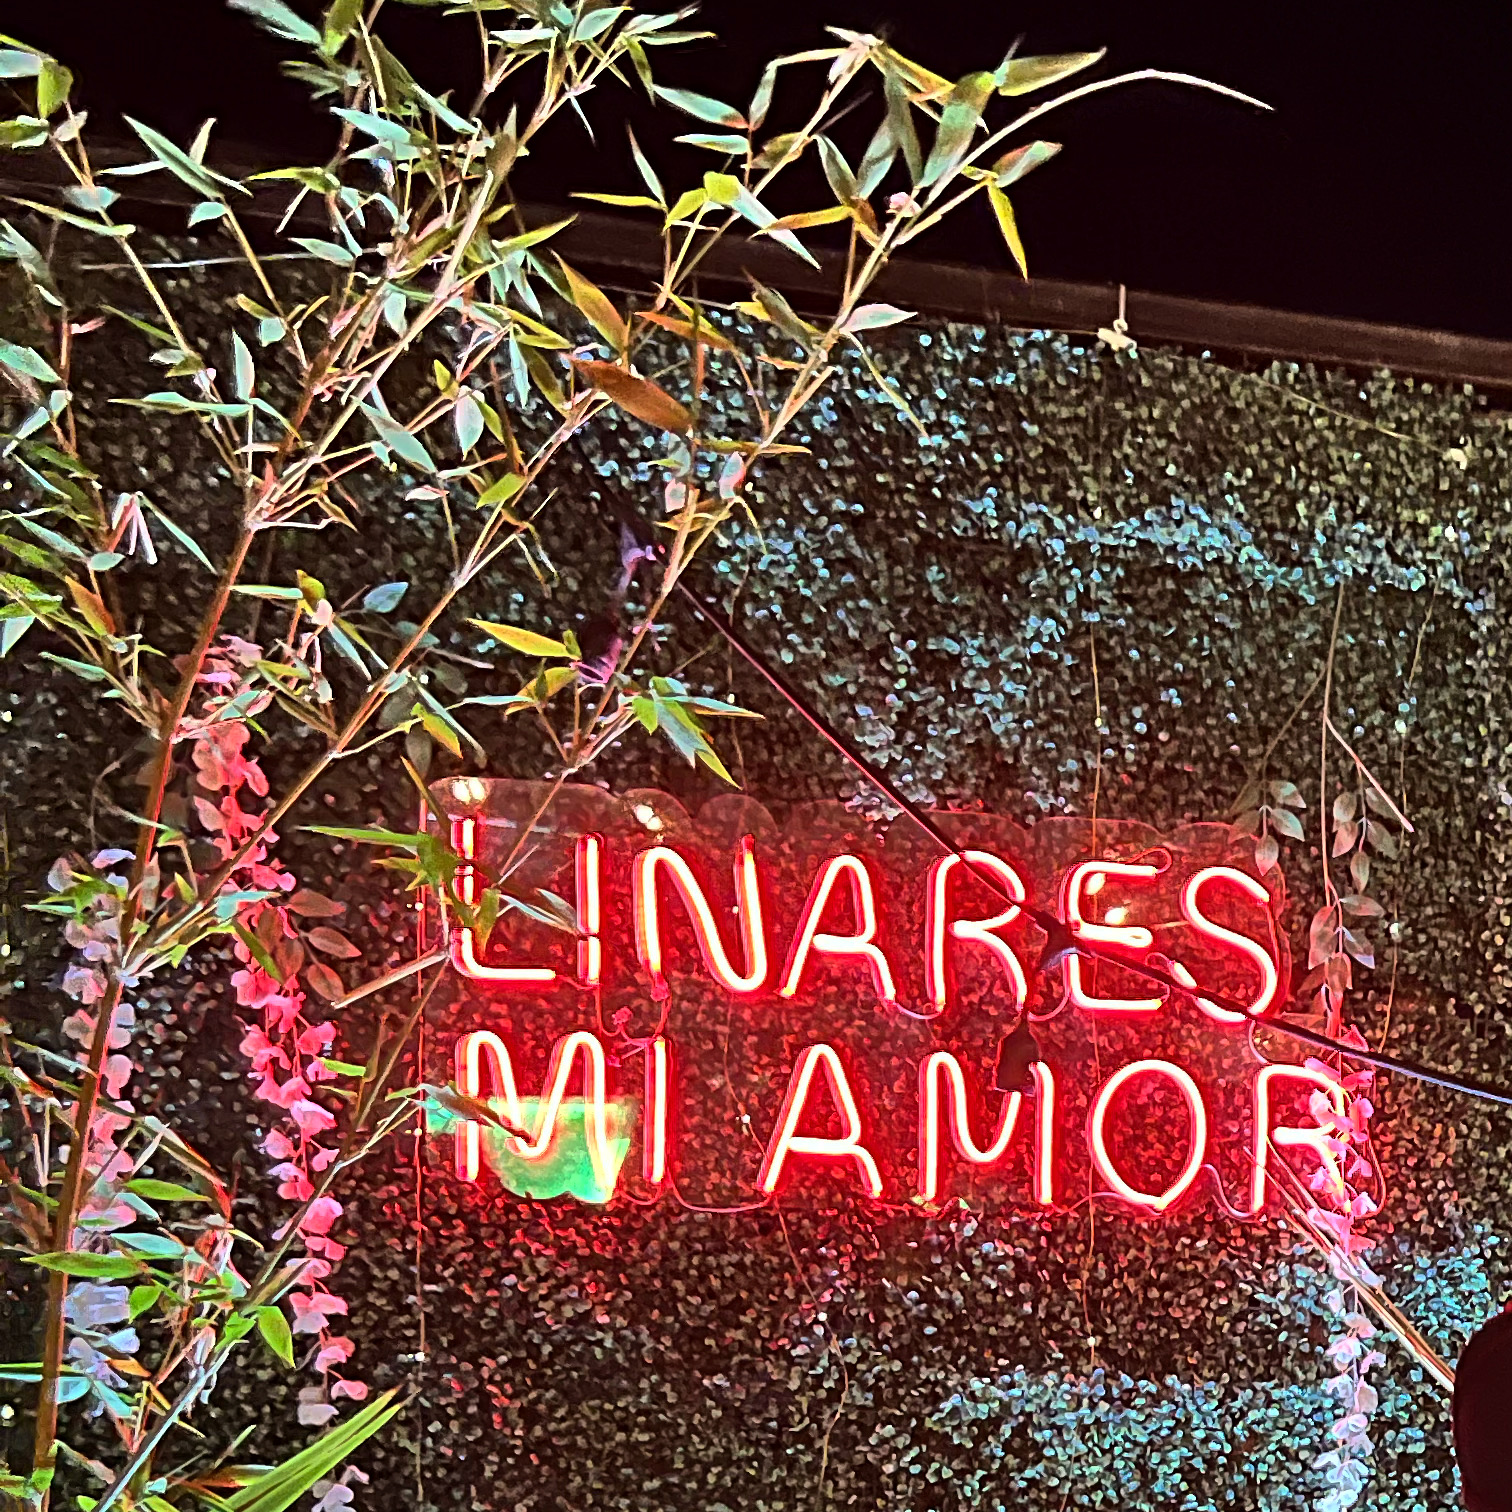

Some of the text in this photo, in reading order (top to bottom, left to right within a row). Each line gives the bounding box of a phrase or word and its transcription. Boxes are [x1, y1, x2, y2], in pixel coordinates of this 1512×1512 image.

[450, 816, 1281, 1023] LINARES
[455, 1030, 1351, 1213] MI AMOR
